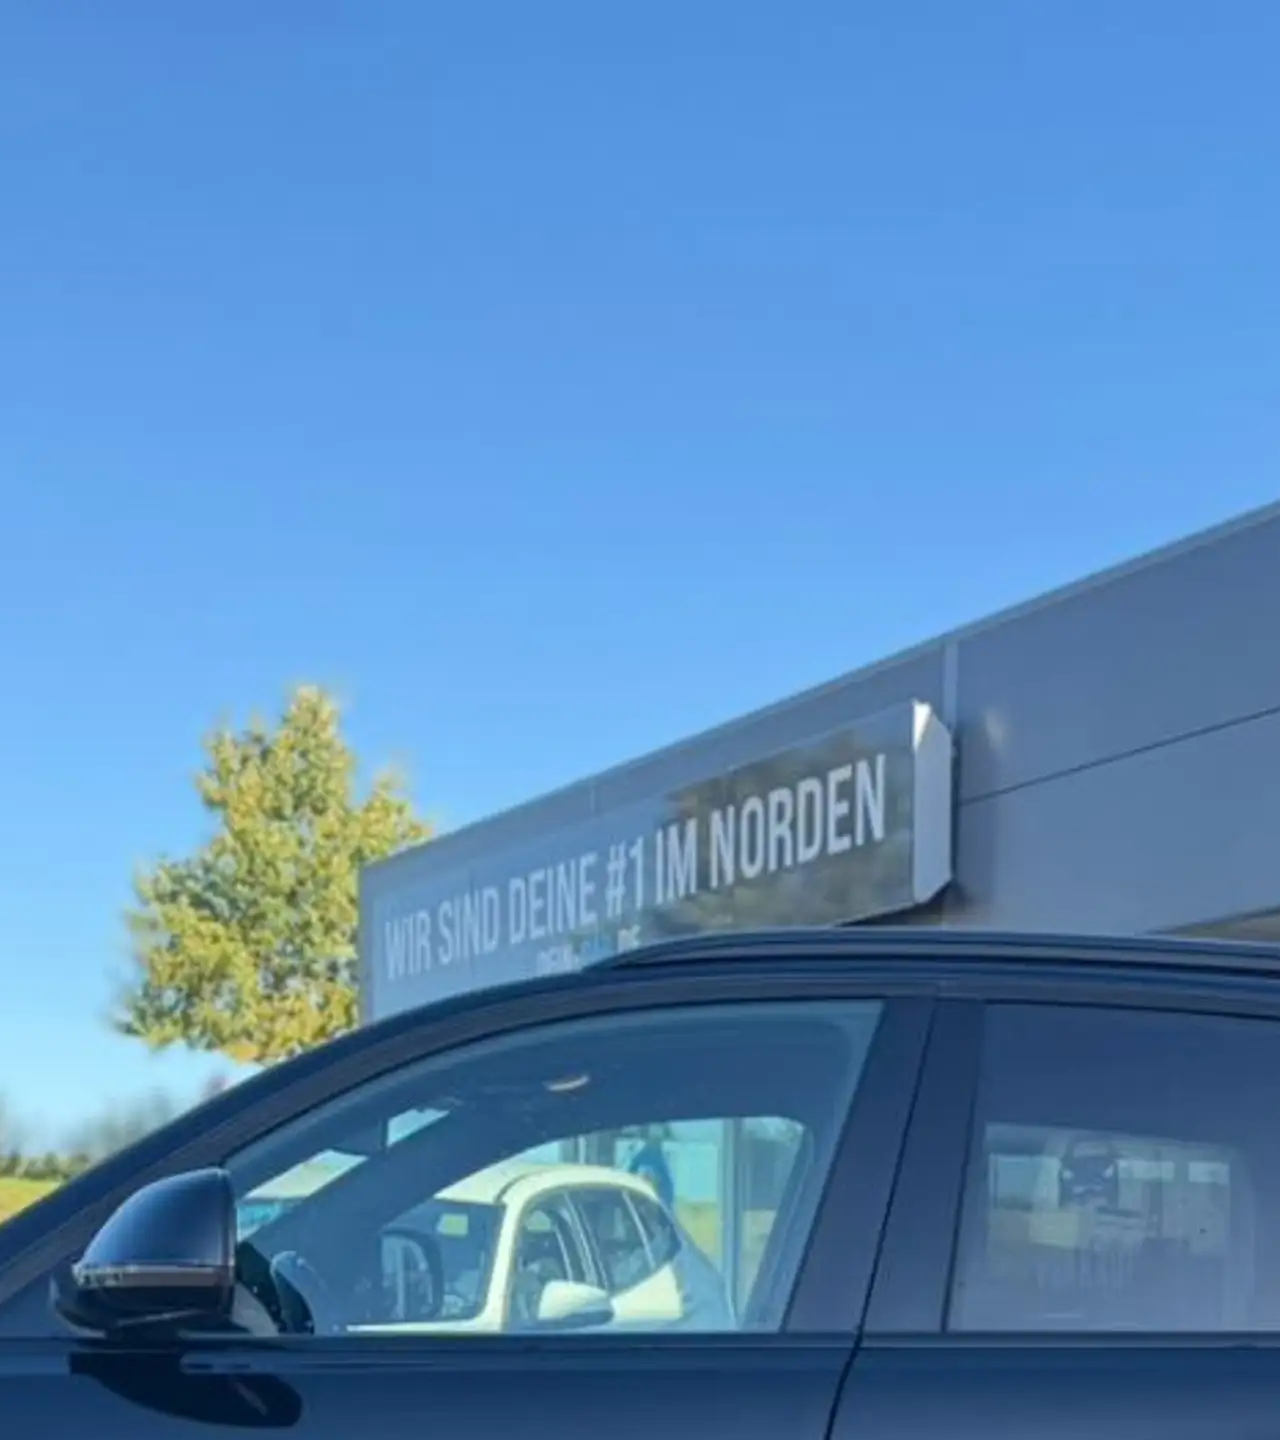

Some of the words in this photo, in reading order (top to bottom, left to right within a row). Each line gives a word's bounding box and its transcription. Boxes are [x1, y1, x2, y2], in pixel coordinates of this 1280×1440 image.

[385, 909, 432, 981] WIR
[438, 886, 500, 965] SIND
[508, 850, 597, 946] DEINE
[606, 835, 646, 920] #1
[655, 816, 699, 904] IM
[710, 753, 887, 890] NORDEN
